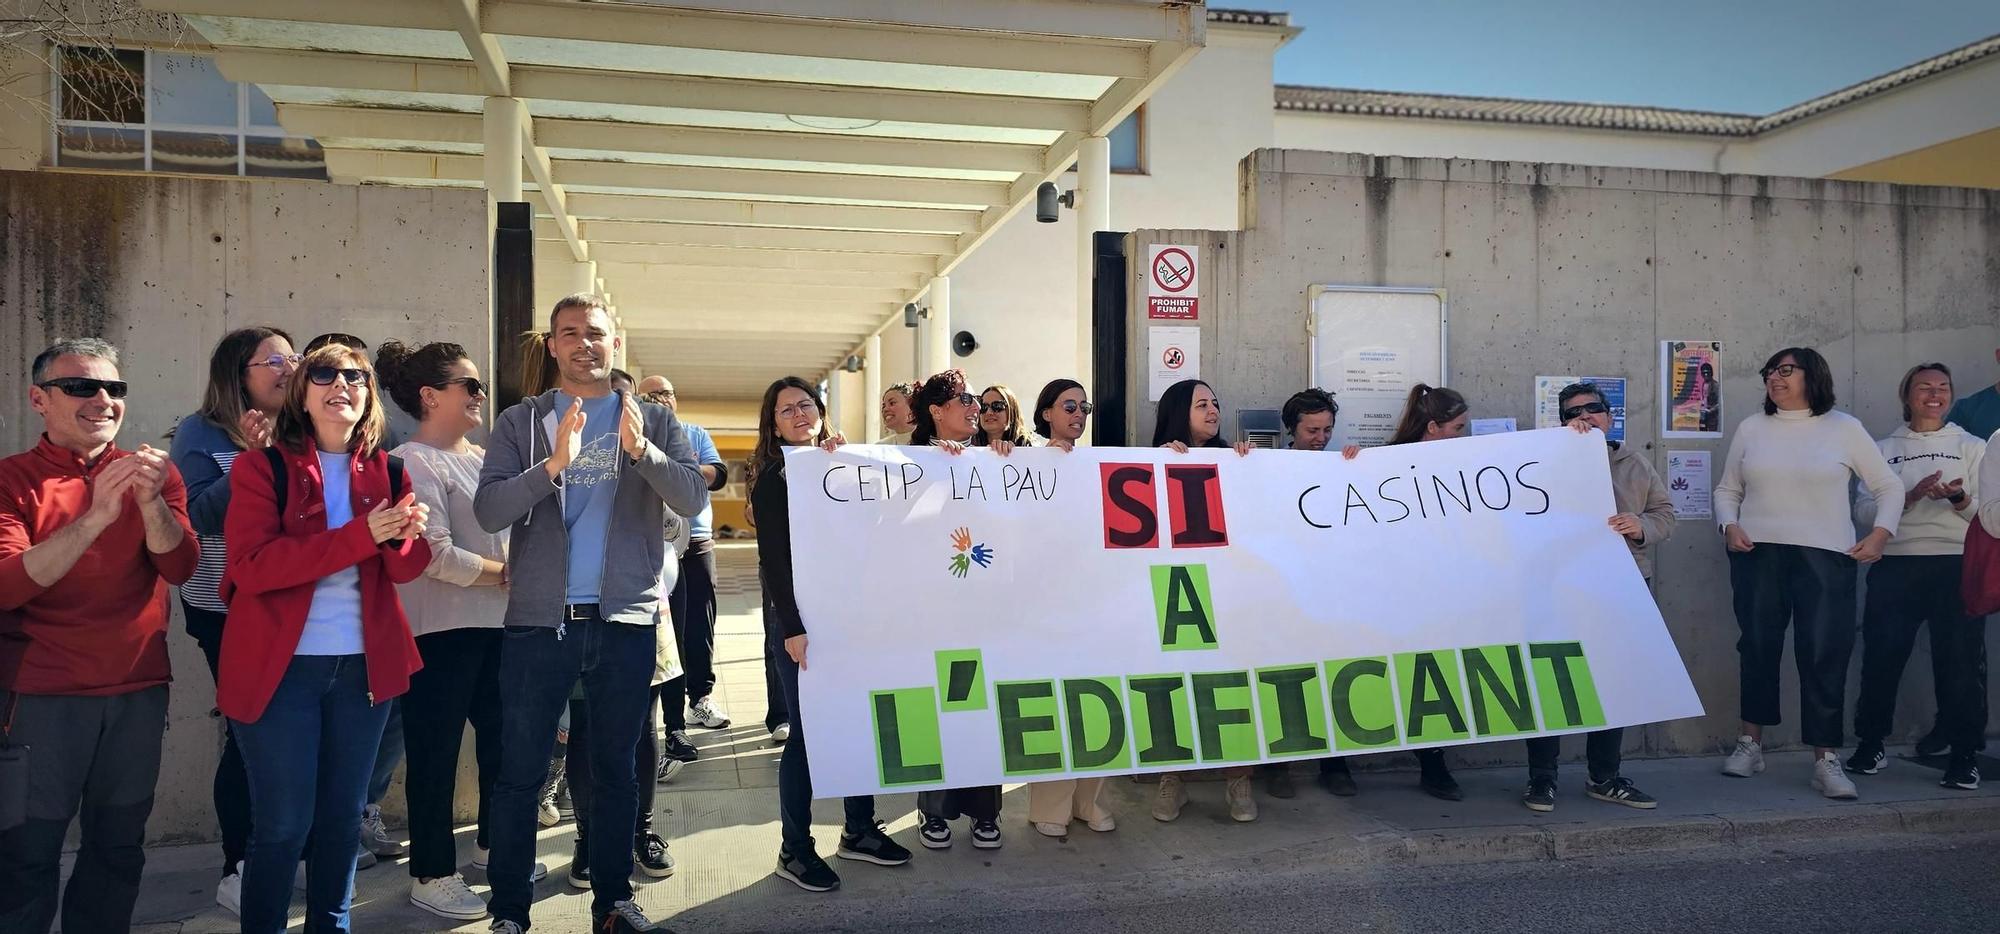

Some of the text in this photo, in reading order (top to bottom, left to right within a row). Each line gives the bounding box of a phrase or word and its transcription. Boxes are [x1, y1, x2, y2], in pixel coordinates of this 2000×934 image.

[1151, 298, 1195, 306] PROHIBIT
[1887, 452, 1961, 464] Champion
[822, 462, 1058, 503] CEIP LA PAU
[1107, 466, 1226, 548] SI
[1162, 566, 1217, 645] A
